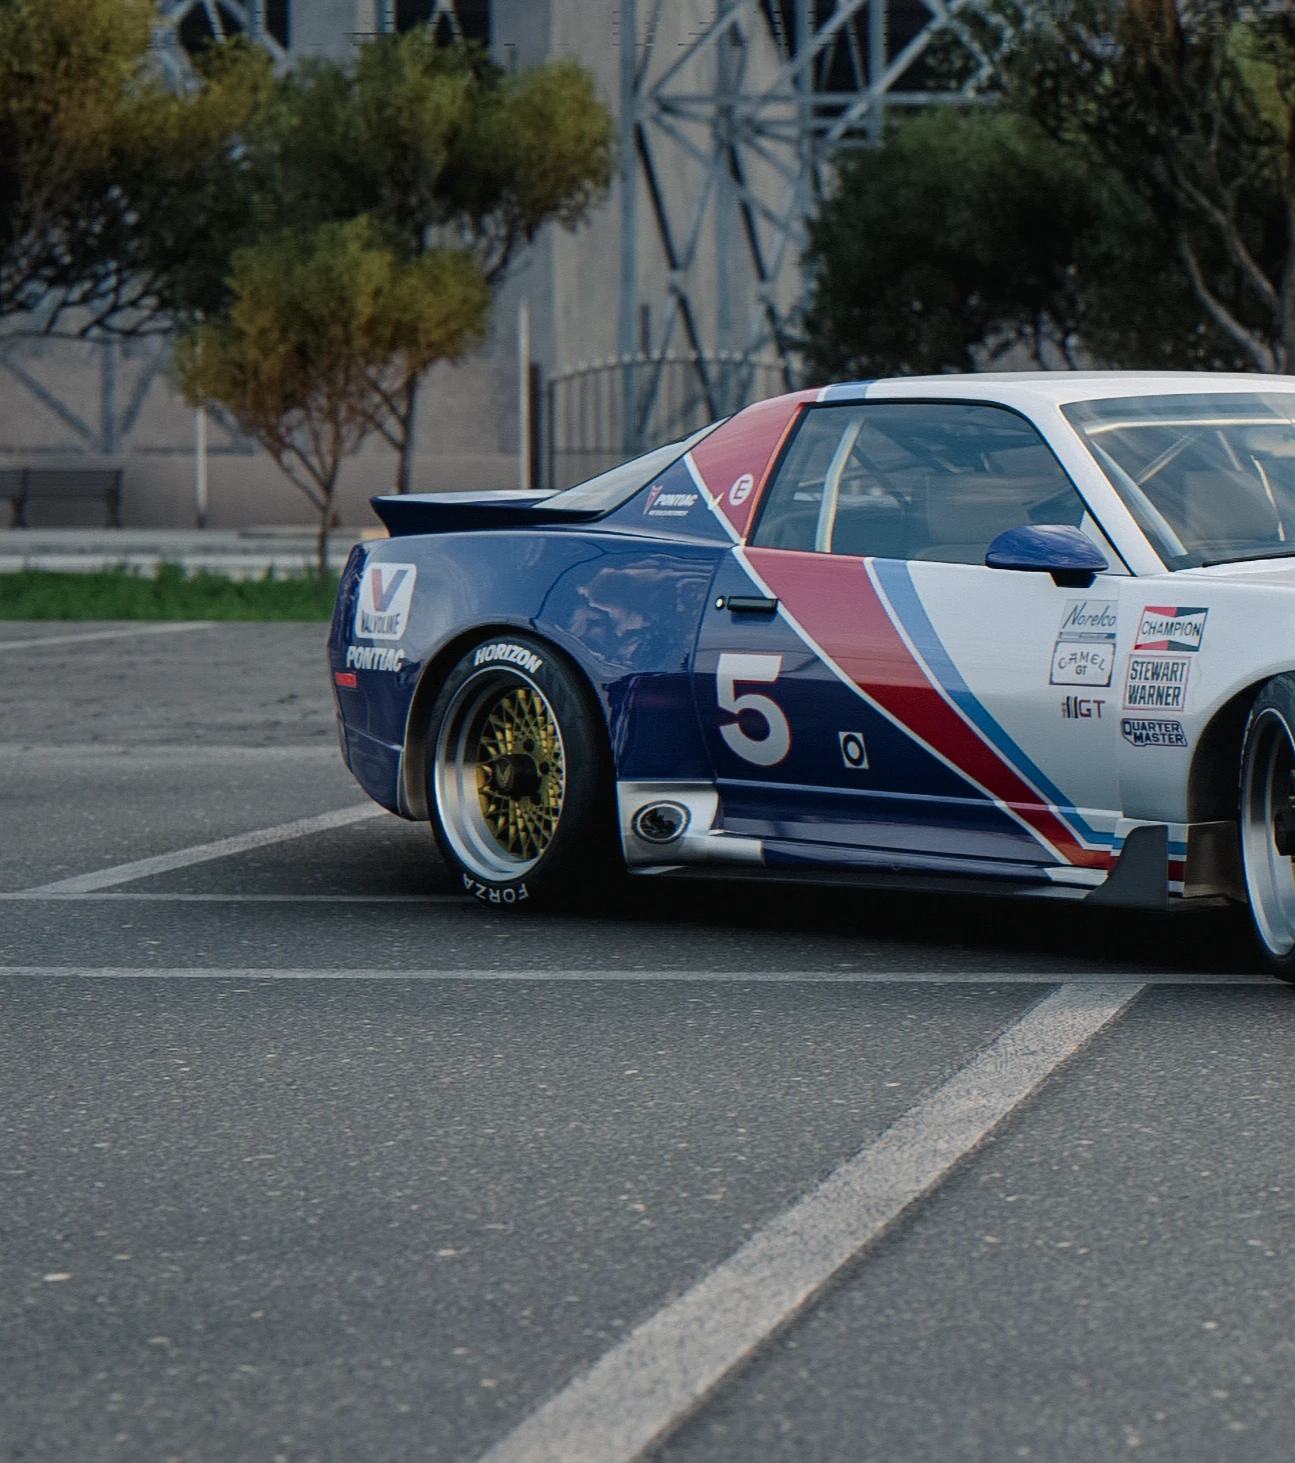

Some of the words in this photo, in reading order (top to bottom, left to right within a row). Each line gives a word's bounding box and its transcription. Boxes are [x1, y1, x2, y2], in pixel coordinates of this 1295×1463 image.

[733, 480, 750, 500] E
[361, 608, 400, 635] VALVOLINE
[1062, 601, 1117, 629] Norelco
[1141, 620, 1202, 637] CHAMPION
[346, 645, 406, 673] PONTIAC
[474, 643, 543, 674] HORIZON
[1058, 651, 1106, 672] CAMEL
[1075, 664, 1088, 676] GT
[1130, 660, 1187, 682] STEWART
[1128, 684, 1182, 707] WARNER
[716, 652, 792, 767] 5
[1123, 720, 1180, 737] QUARTER
[1133, 733, 1184, 745] MASTER
[462, 872, 530, 903] FORZA
